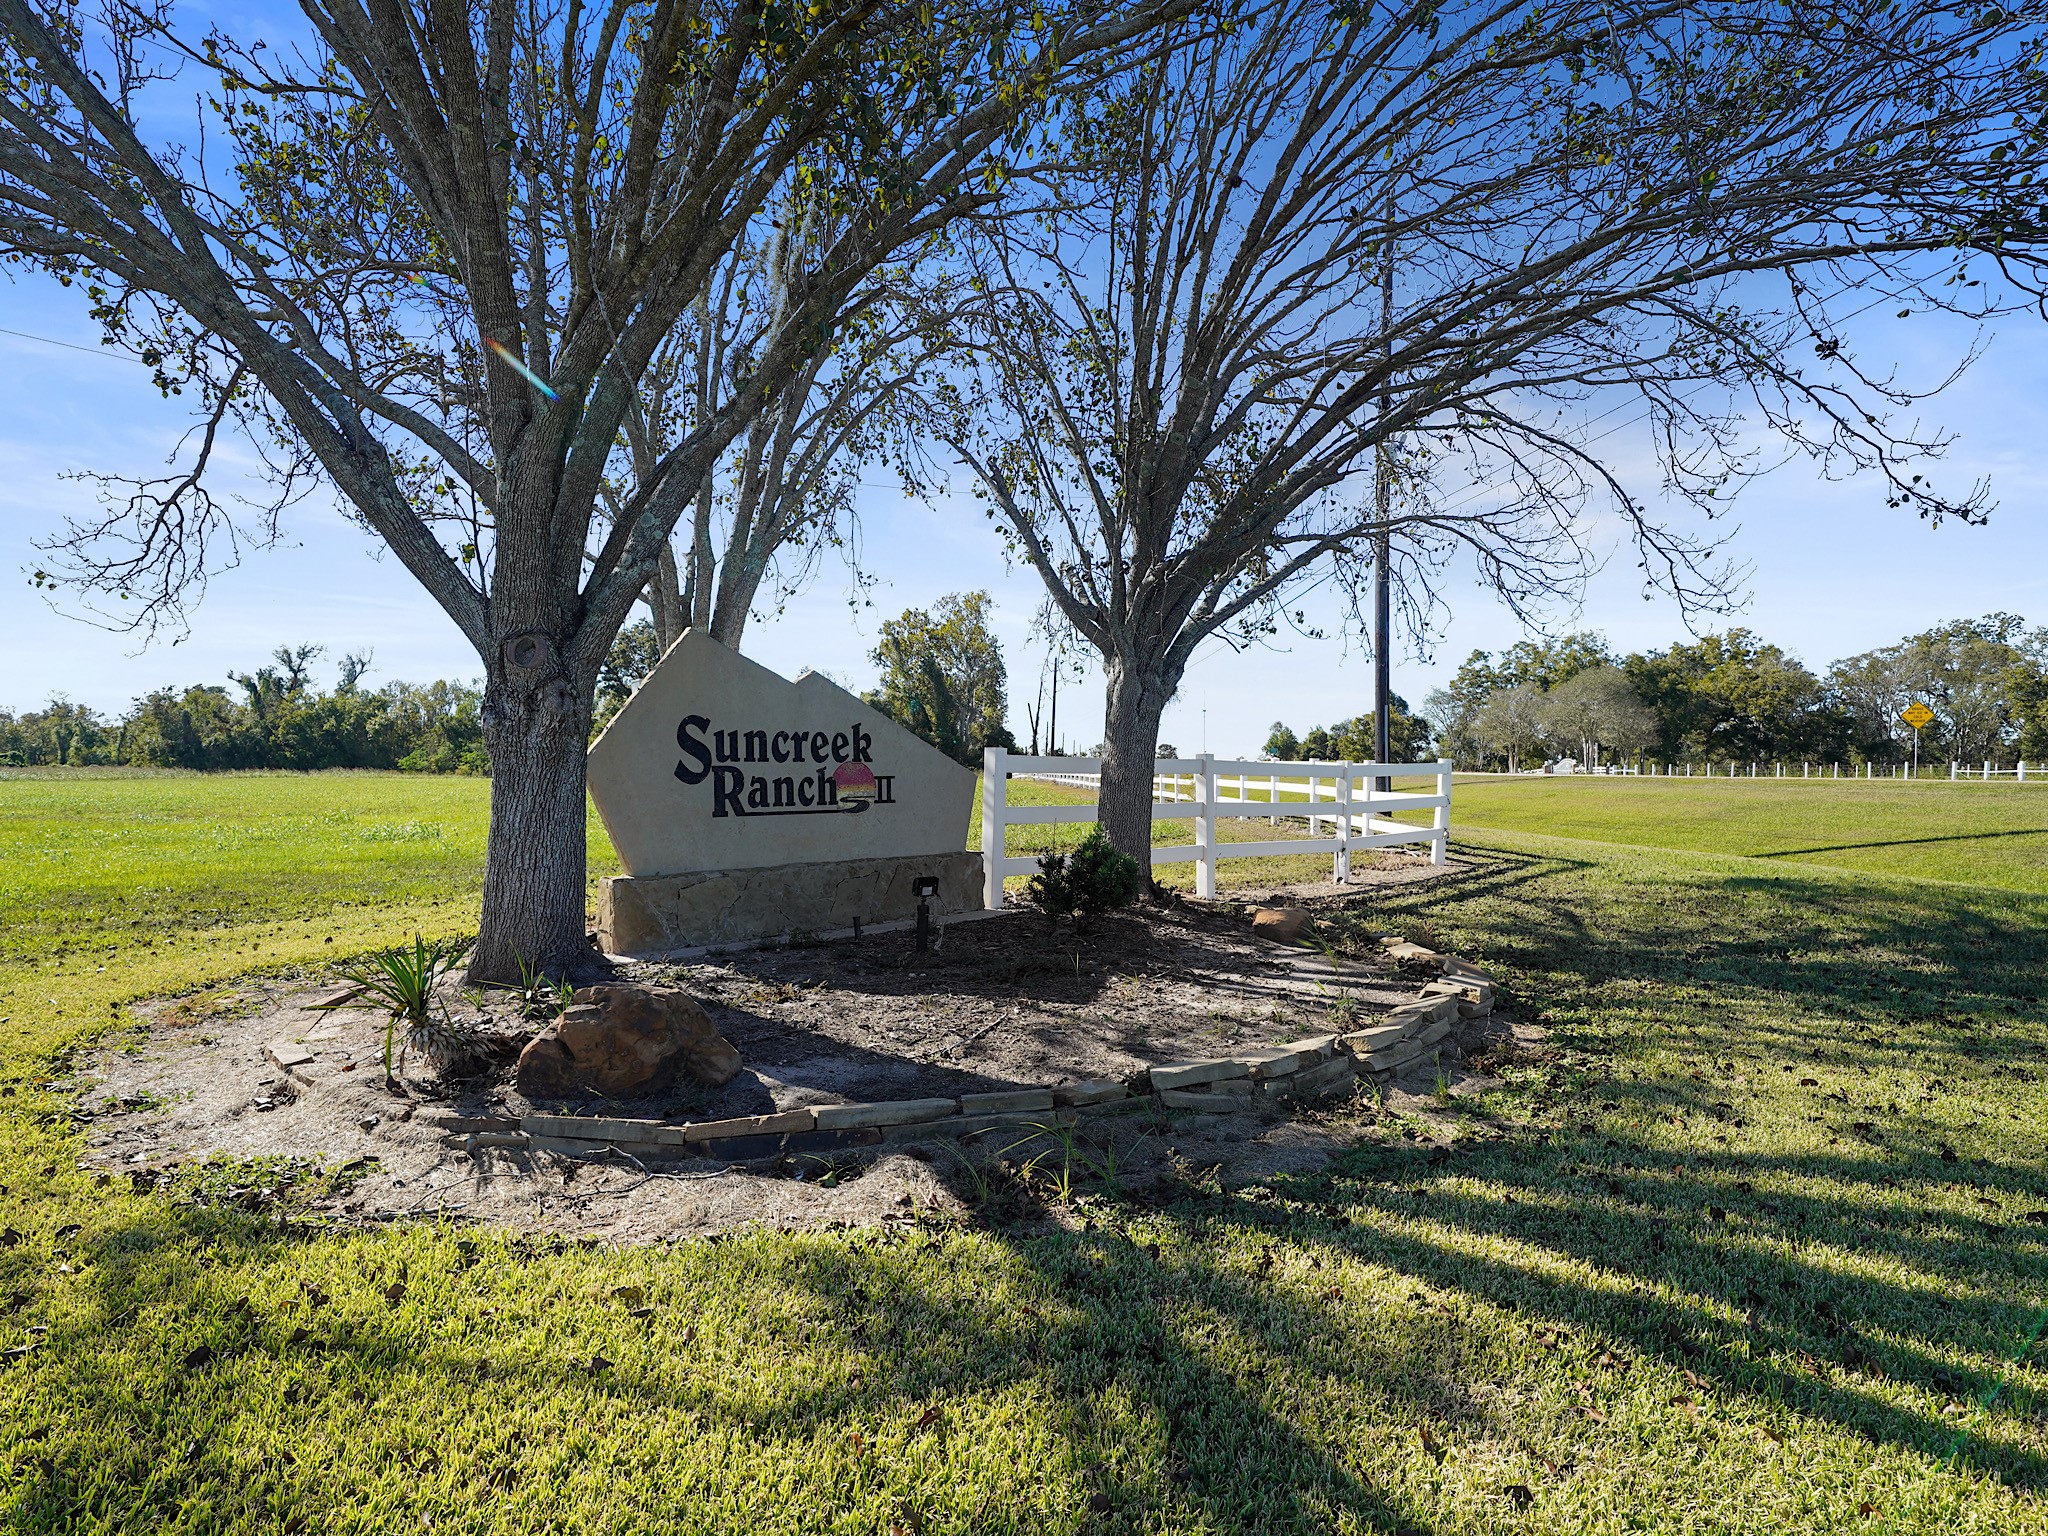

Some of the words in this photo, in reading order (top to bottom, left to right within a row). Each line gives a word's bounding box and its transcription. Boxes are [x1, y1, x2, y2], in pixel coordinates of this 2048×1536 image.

[674, 714, 873, 785] Suncreek
[711, 765, 839, 818] Ranch
[874, 775, 896, 804] II
